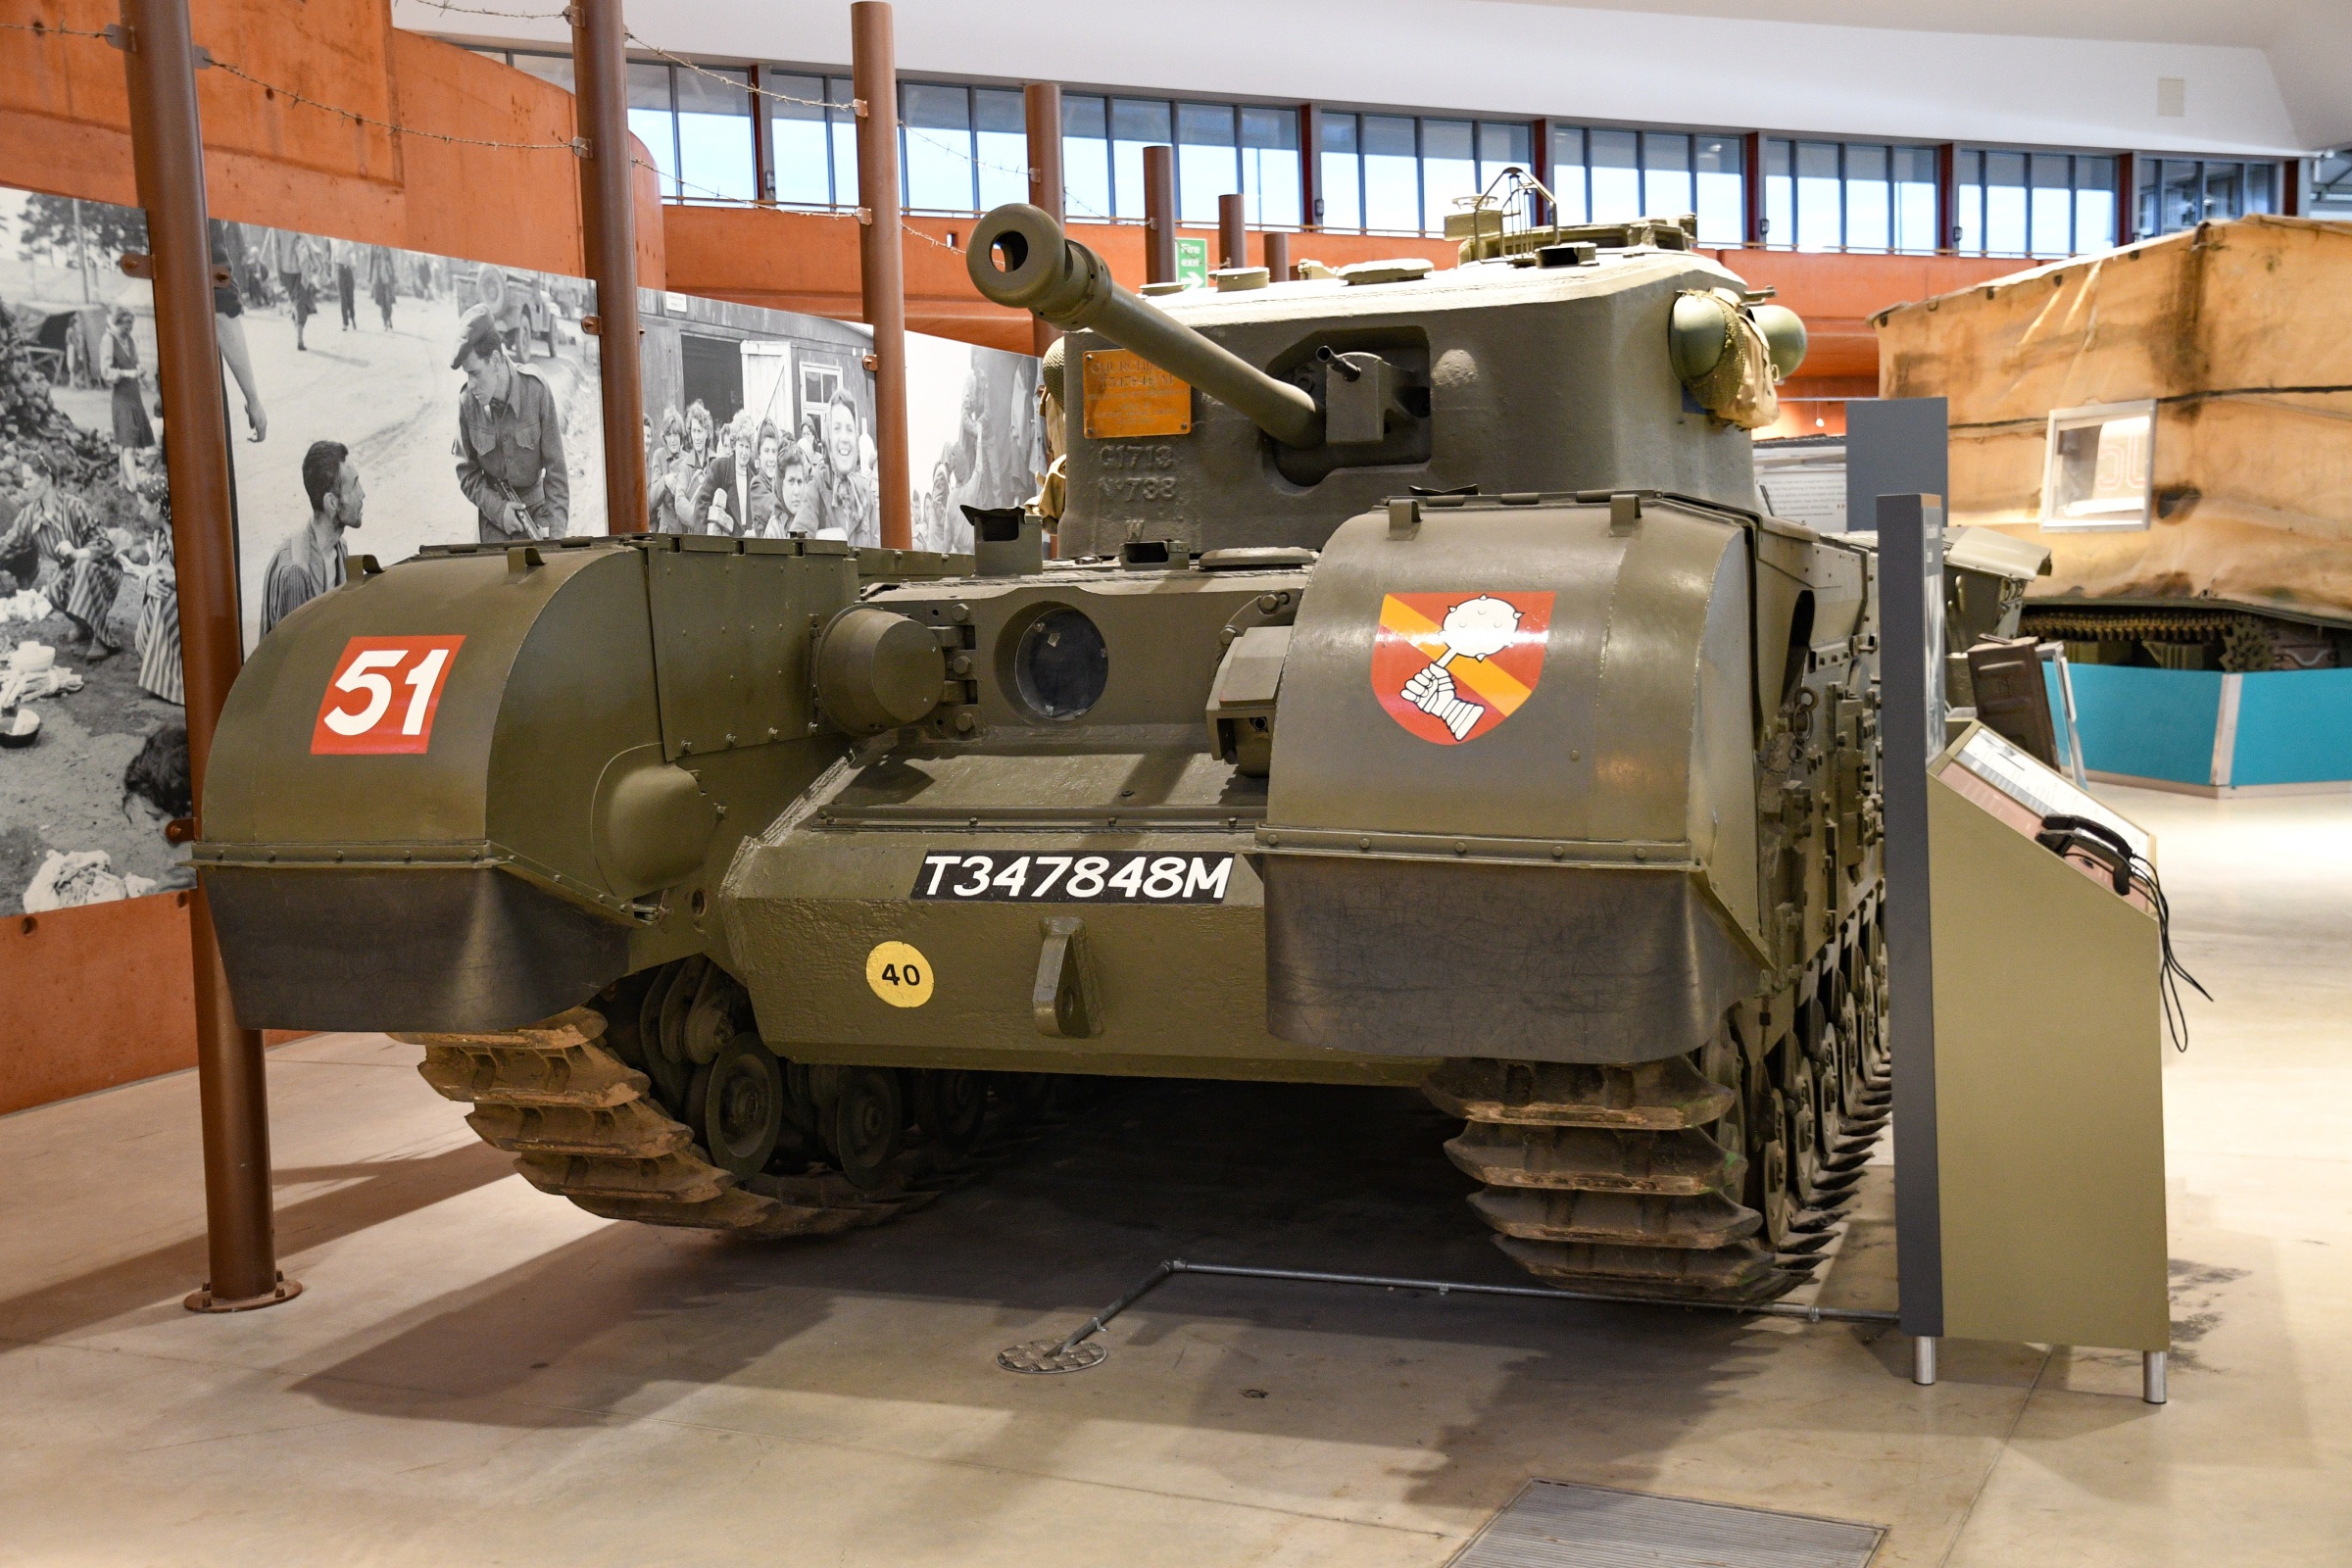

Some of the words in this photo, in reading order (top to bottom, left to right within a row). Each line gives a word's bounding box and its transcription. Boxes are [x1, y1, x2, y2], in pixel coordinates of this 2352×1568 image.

[1181, 243, 1200, 255] Fire
[1181, 258, 1200, 268] exit
[323, 649, 450, 736] 51
[924, 856, 1234, 899] T347848M
[881, 963, 921, 987] 40
